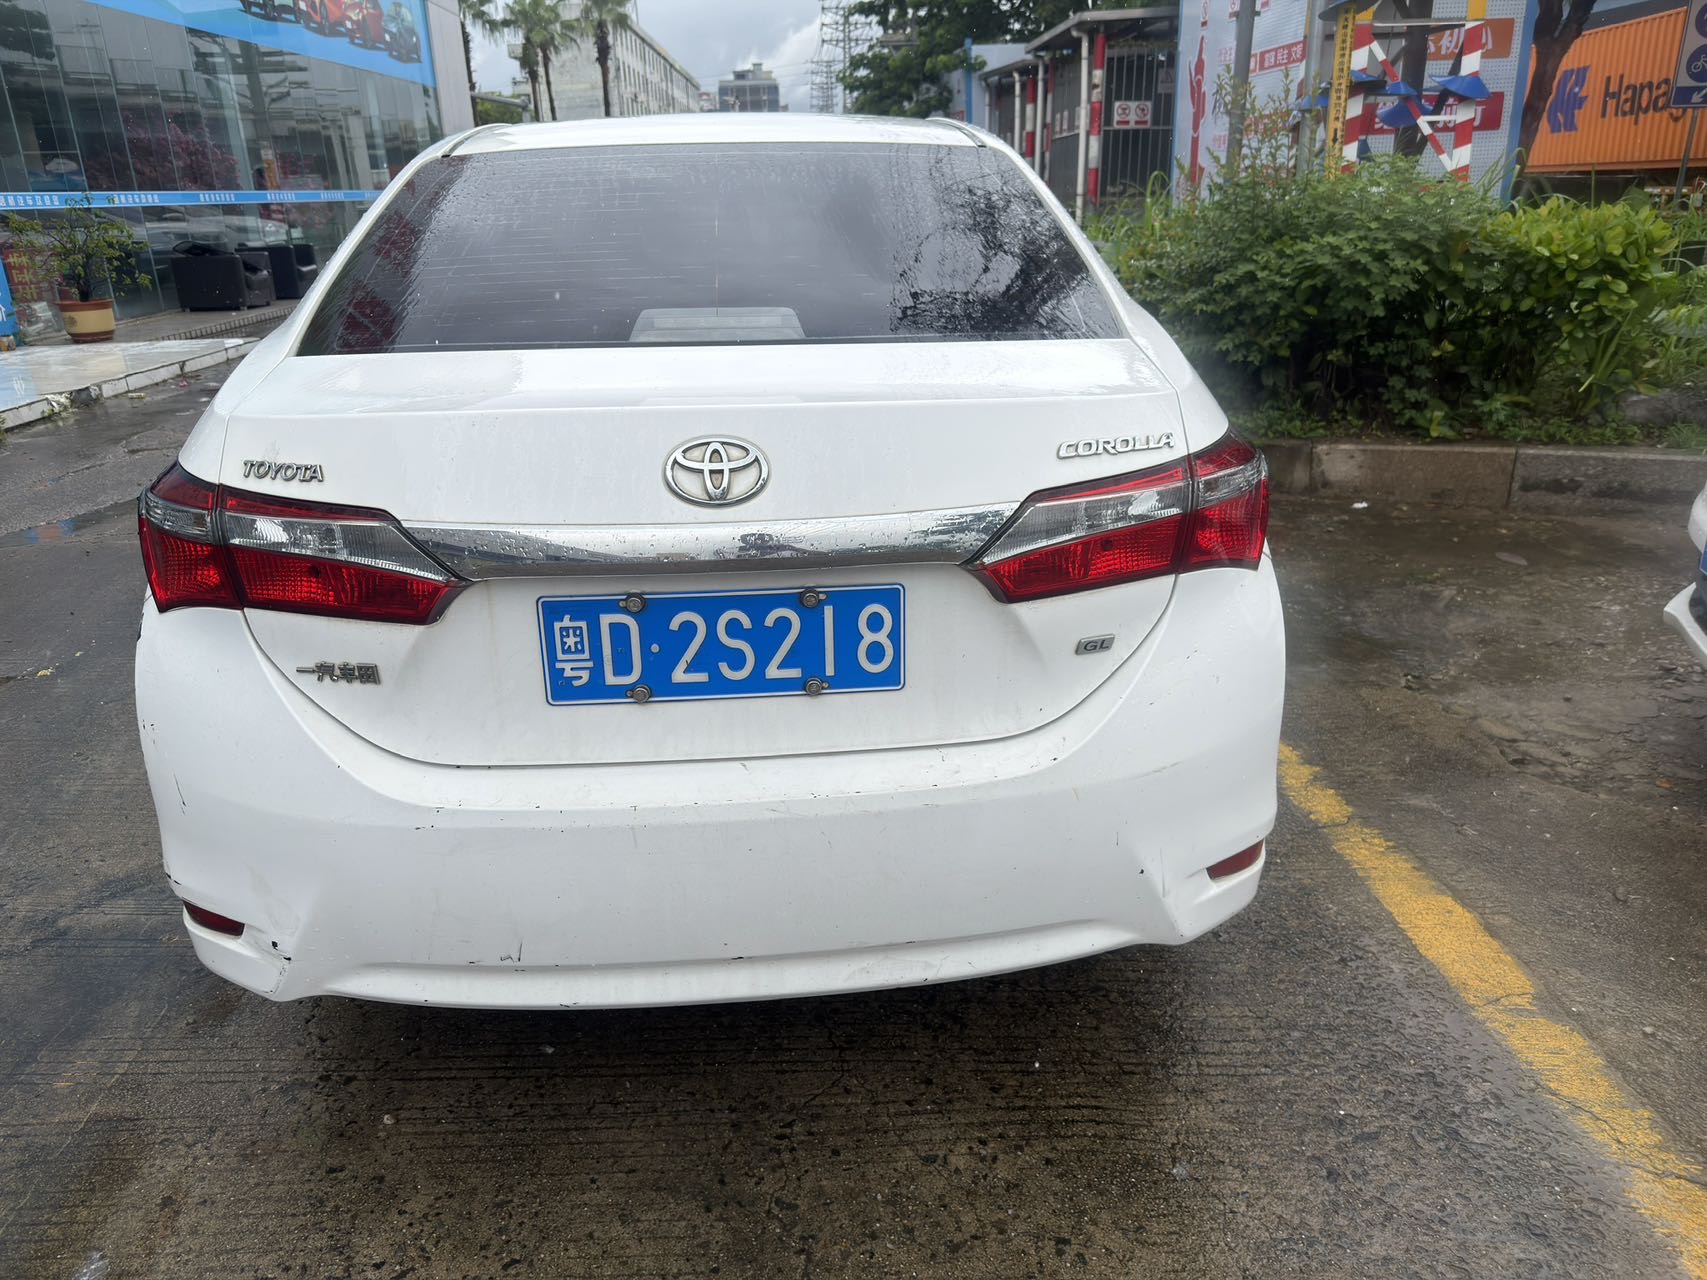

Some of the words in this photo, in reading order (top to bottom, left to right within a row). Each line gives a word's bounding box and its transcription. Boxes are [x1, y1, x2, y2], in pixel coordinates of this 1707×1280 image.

[1057, 432, 1176, 459] COROLLA
[242, 459, 325, 483] TOYOTA
[1083, 638, 1111, 652] GL
